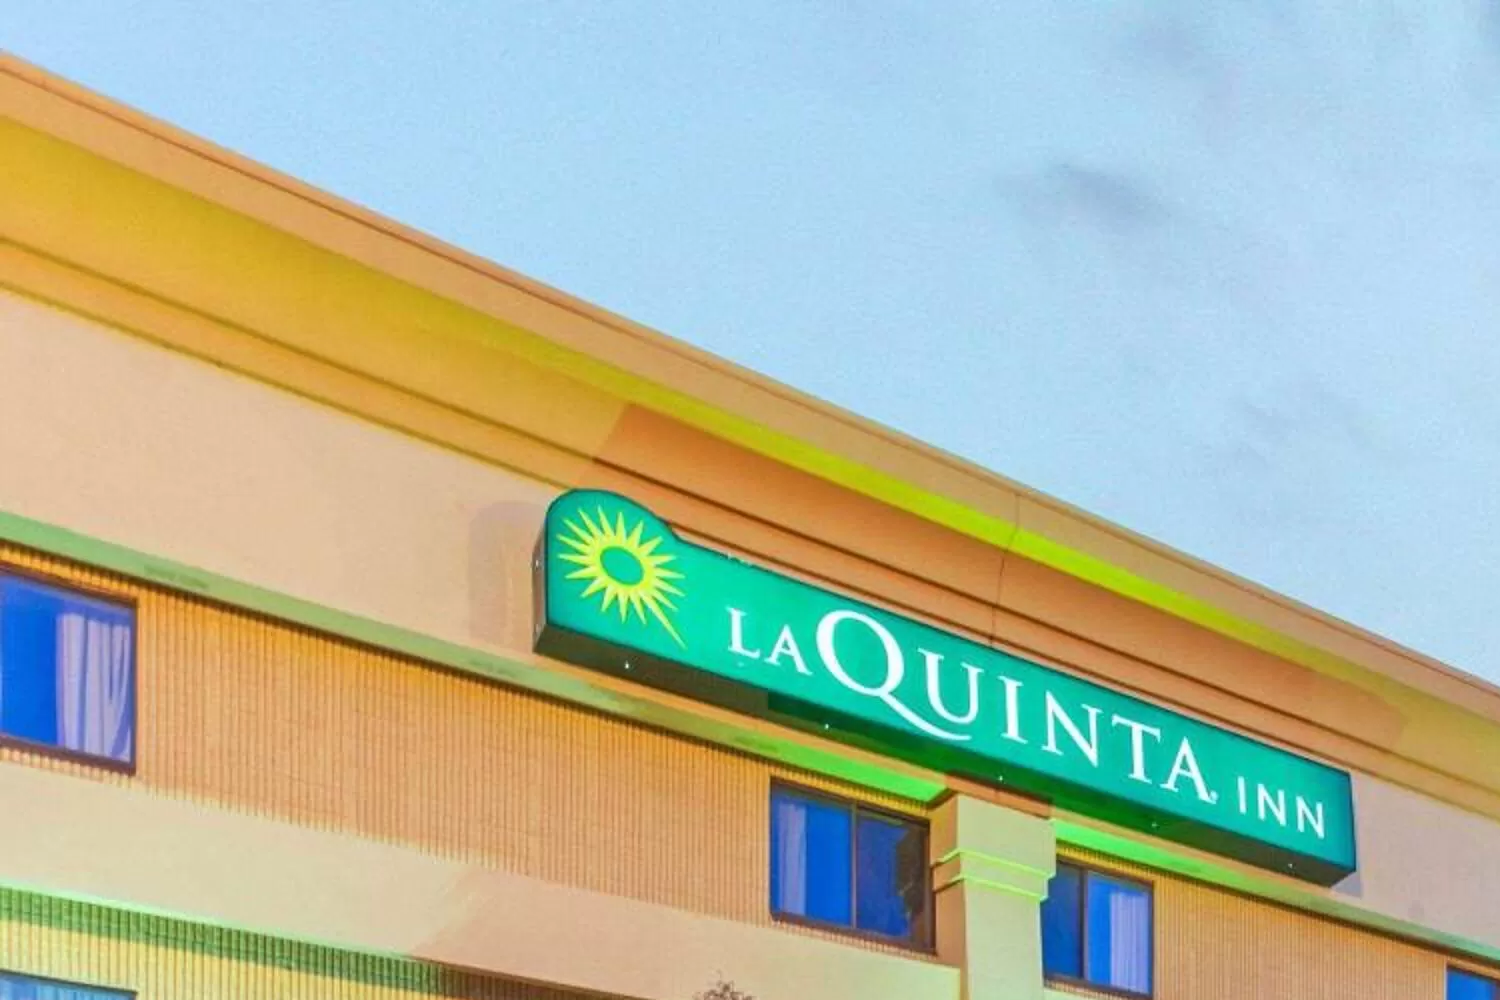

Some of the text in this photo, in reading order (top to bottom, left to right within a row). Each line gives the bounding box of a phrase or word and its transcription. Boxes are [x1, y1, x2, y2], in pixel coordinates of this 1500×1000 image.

[726, 606, 1325, 839] LA QUINTA INN
